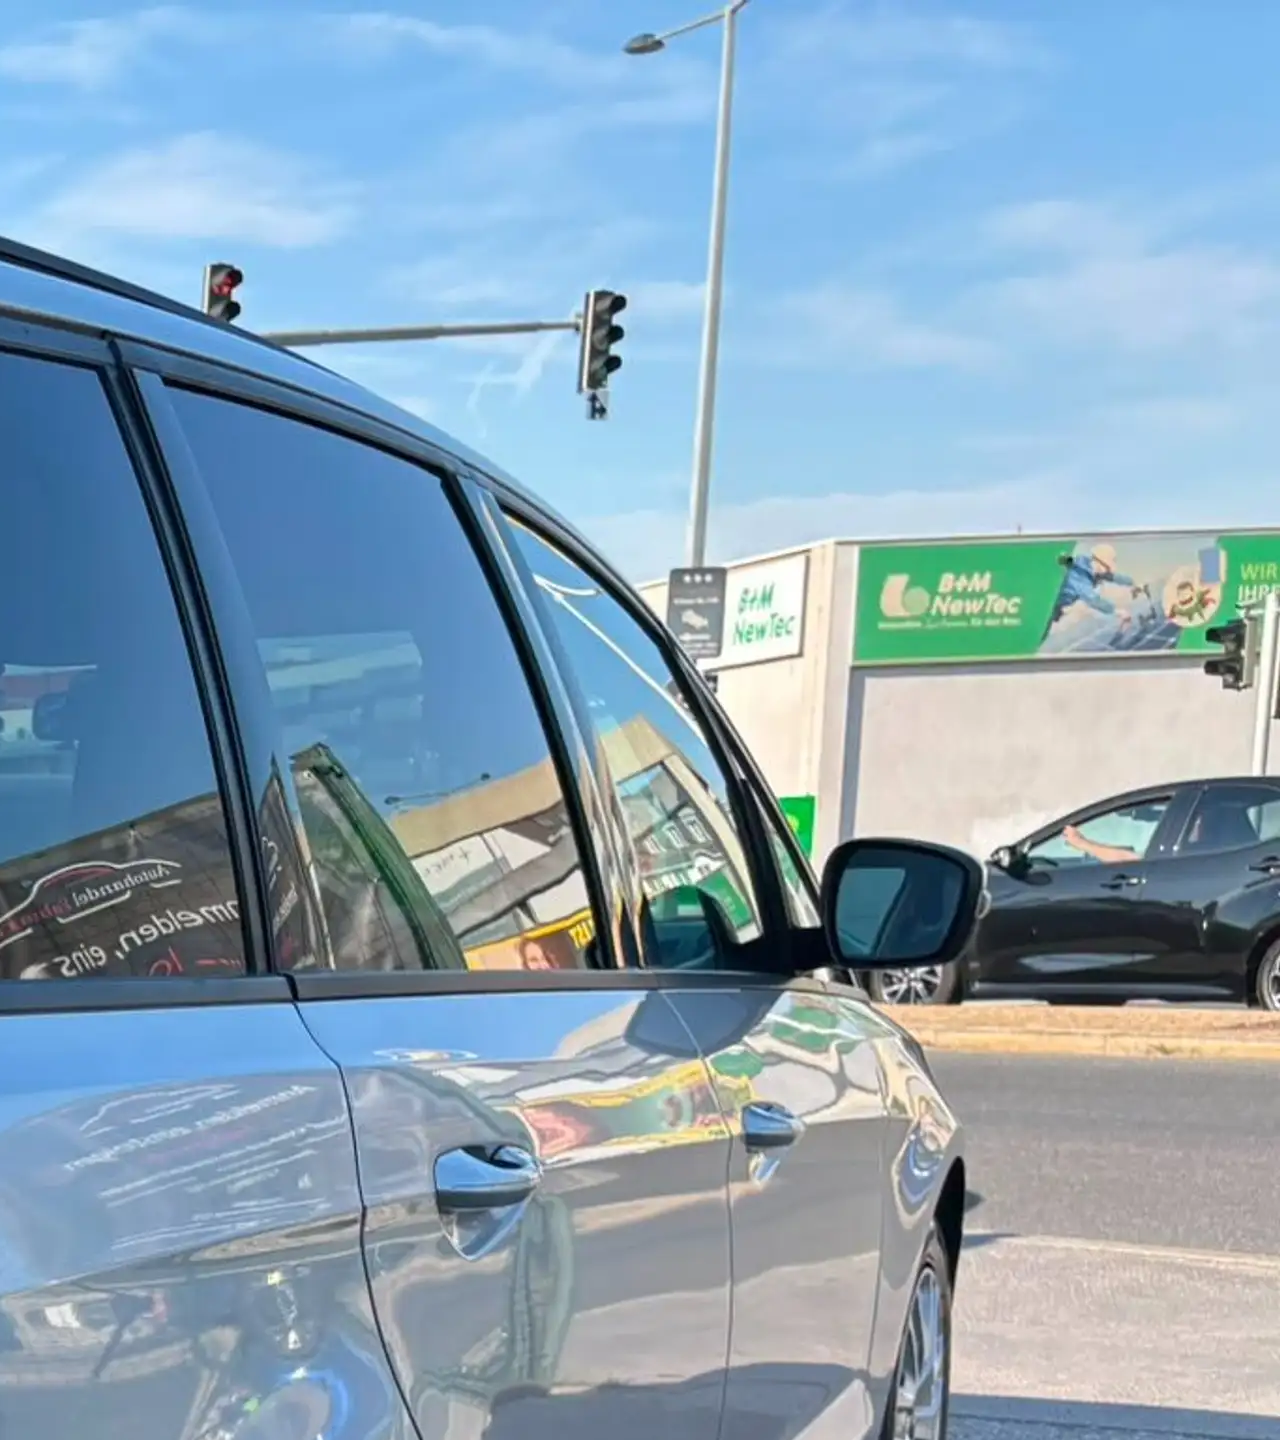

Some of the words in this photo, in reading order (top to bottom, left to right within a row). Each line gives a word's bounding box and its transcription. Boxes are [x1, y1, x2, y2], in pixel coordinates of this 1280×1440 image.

[938, 570, 991, 594] B+M
[1240, 562, 1277, 581] WIR
[930, 593, 1022, 617] NewTec
[731, 611, 796, 646] NewTec
